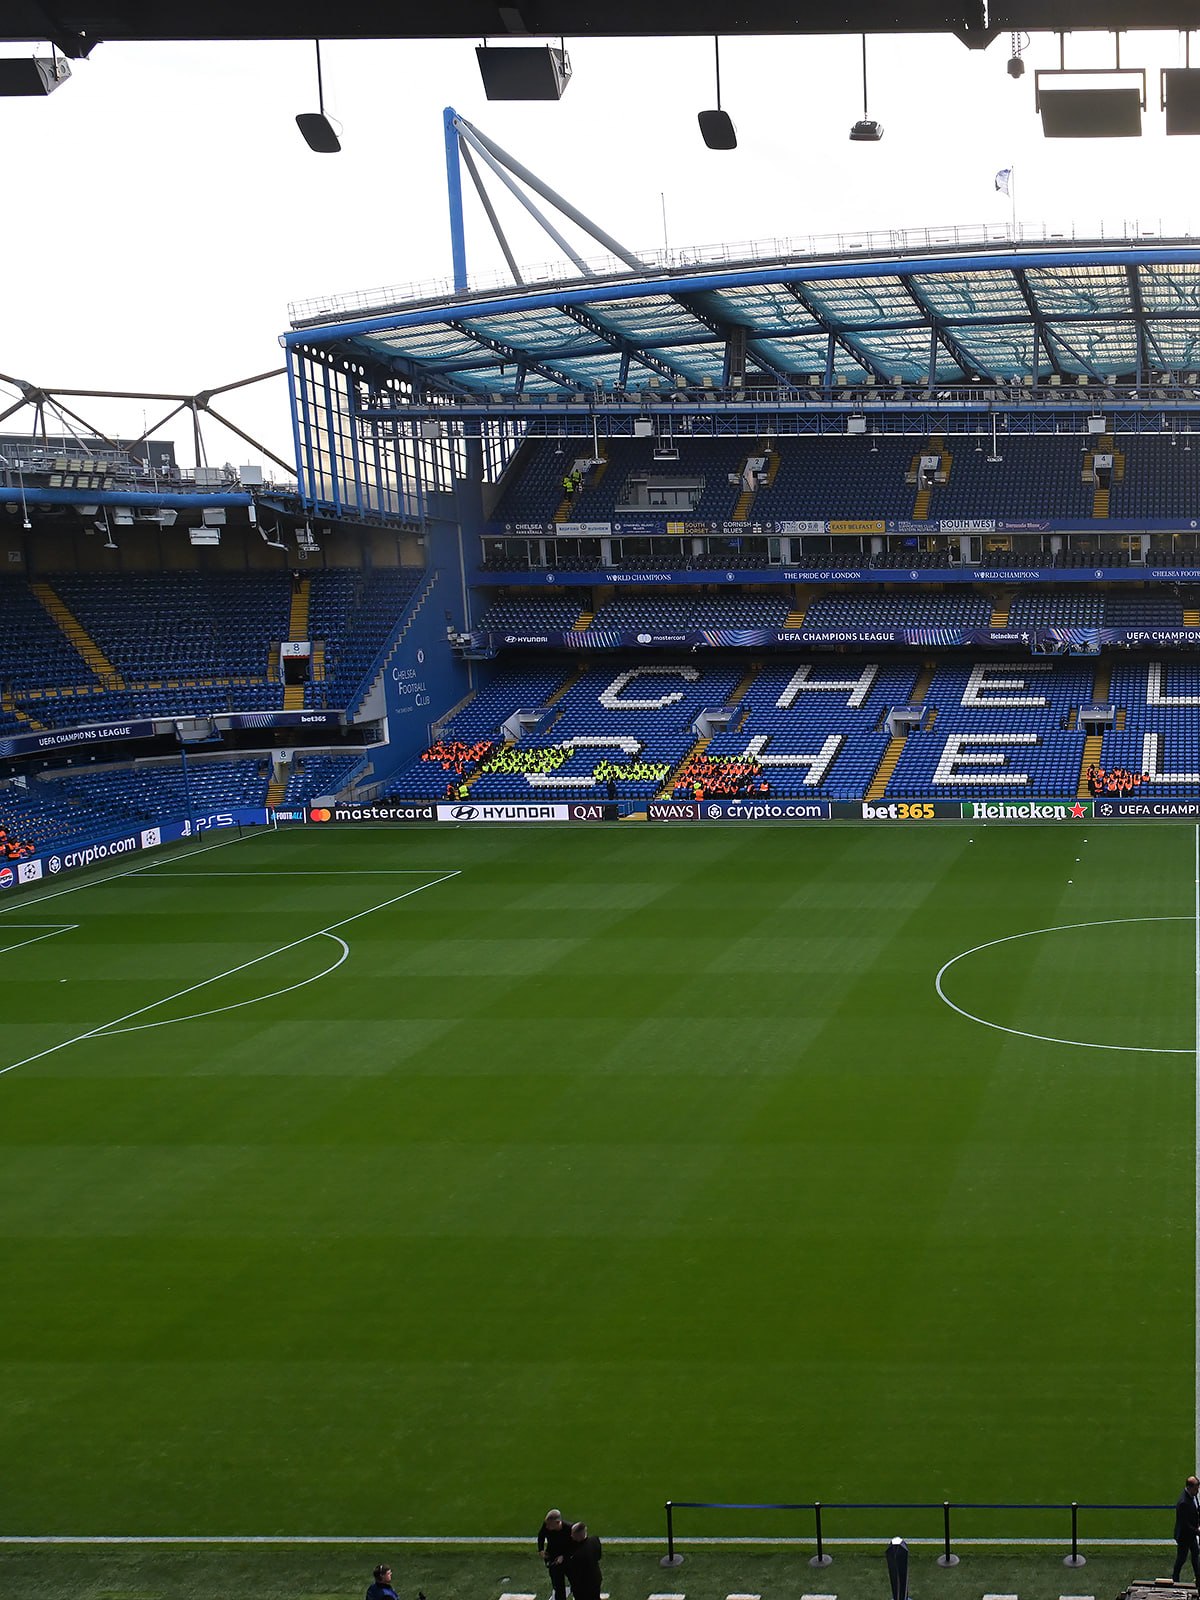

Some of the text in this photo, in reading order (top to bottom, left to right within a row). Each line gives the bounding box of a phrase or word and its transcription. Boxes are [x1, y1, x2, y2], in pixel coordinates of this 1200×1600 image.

[941, 520, 995, 529] SOUTH WEST
[999, 571, 1040, 579] CHAMPIONS
[777, 632, 895, 641] UEFA CHAMPIONS LEAGUE
[990, 632, 1019, 640] Heineken
[1126, 631, 1150, 640] UEFA
[293, 643, 300, 651] 8
[301, 715, 326, 723] bet365
[39, 727, 131, 746] UEFA CHAMPIONS LEAGUE
[280, 750, 286, 758] 8
[335, 806, 433, 820] mastercard
[483, 806, 555, 818] HYUNDAI
[727, 804, 821, 820] crypto.com
[862, 802, 935, 819] bet365
[972, 802, 1066, 819] Heineken
[1119, 804, 1150, 815] UEFA
[196, 813, 236, 830] PS5
[64, 836, 136, 868] crypto.com
